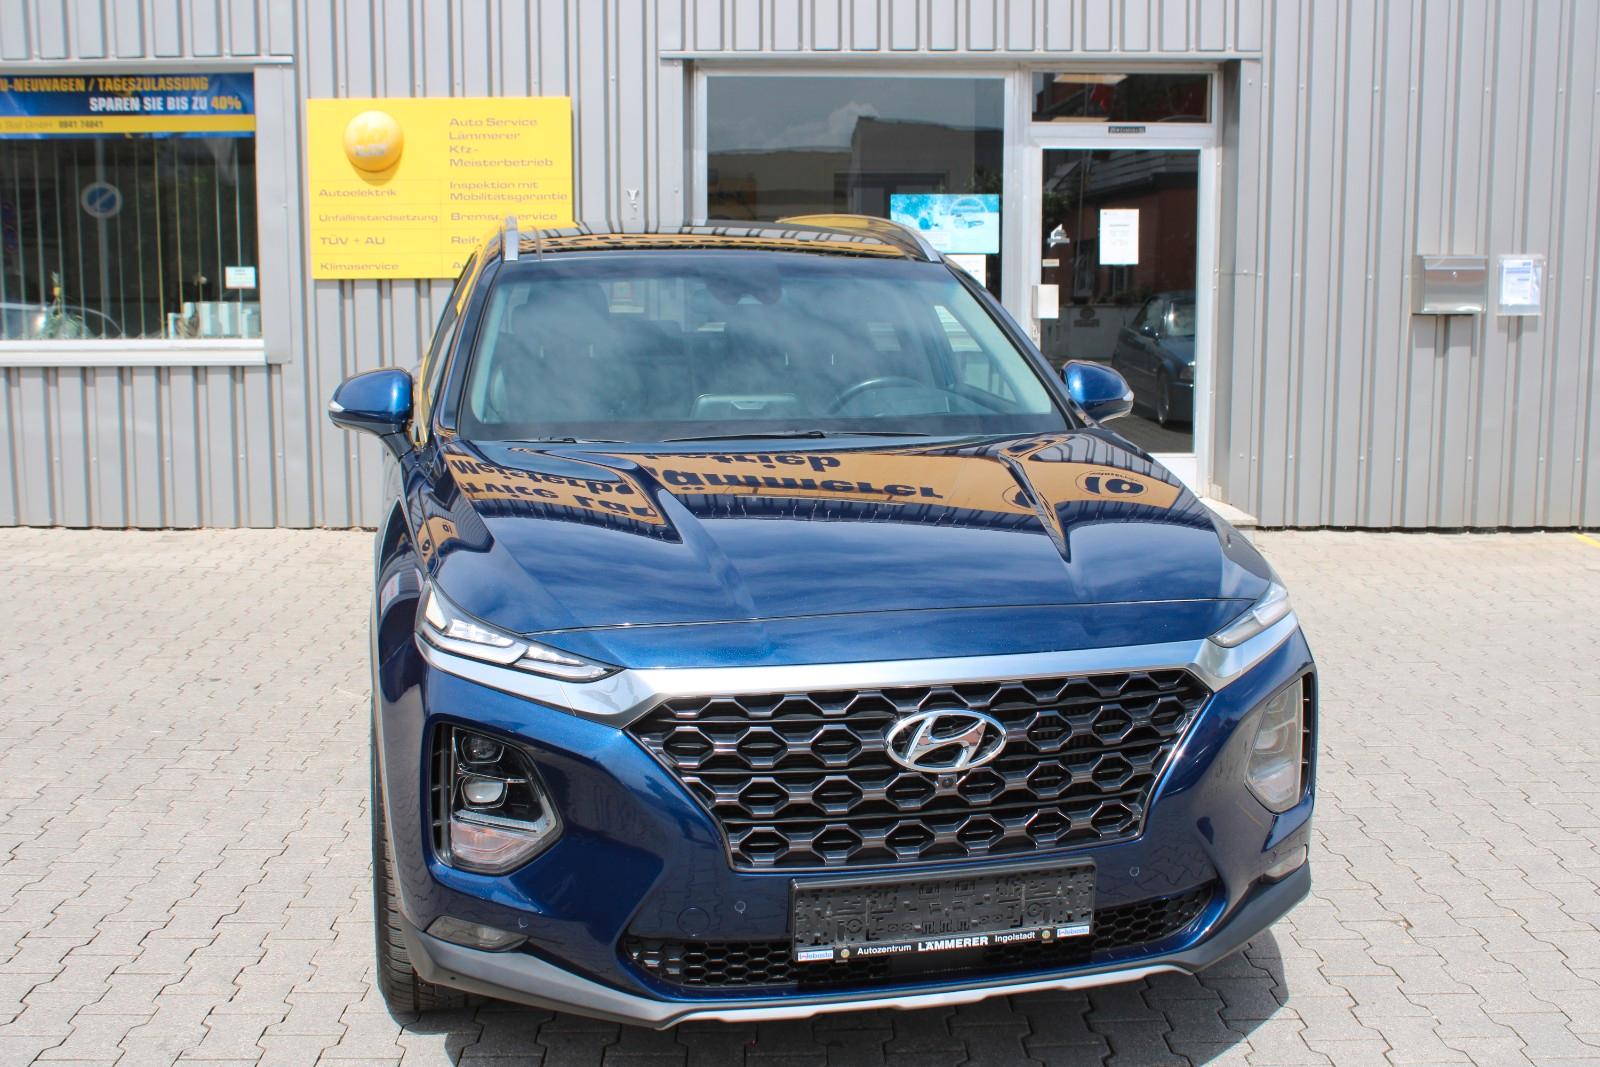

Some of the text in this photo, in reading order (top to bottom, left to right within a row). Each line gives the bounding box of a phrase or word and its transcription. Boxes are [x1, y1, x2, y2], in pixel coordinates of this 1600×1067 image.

[98, 76, 209, 91] TAGESZULASSUNG
[89, 95, 242, 112] SPAREN SIE BIS ZU 40%
[449, 117, 538, 127] Auto Service
[449, 131, 520, 140] Lämmerer
[449, 158, 554, 167] Meisterbetrieb
[449, 181, 539, 191] Inspektion mit
[318, 188, 397, 197] Autoelektrik
[318, 213, 439, 223] Unfallinstandsetzung
[319, 235, 349, 245] TÜV
[365, 236, 386, 245] AU
[319, 261, 400, 271] Klimaservice
[857, 943, 912, 956] Autozentrum
[918, 935, 989, 952] LÄMMERER
[994, 931, 1036, 943] Ingolstadt
